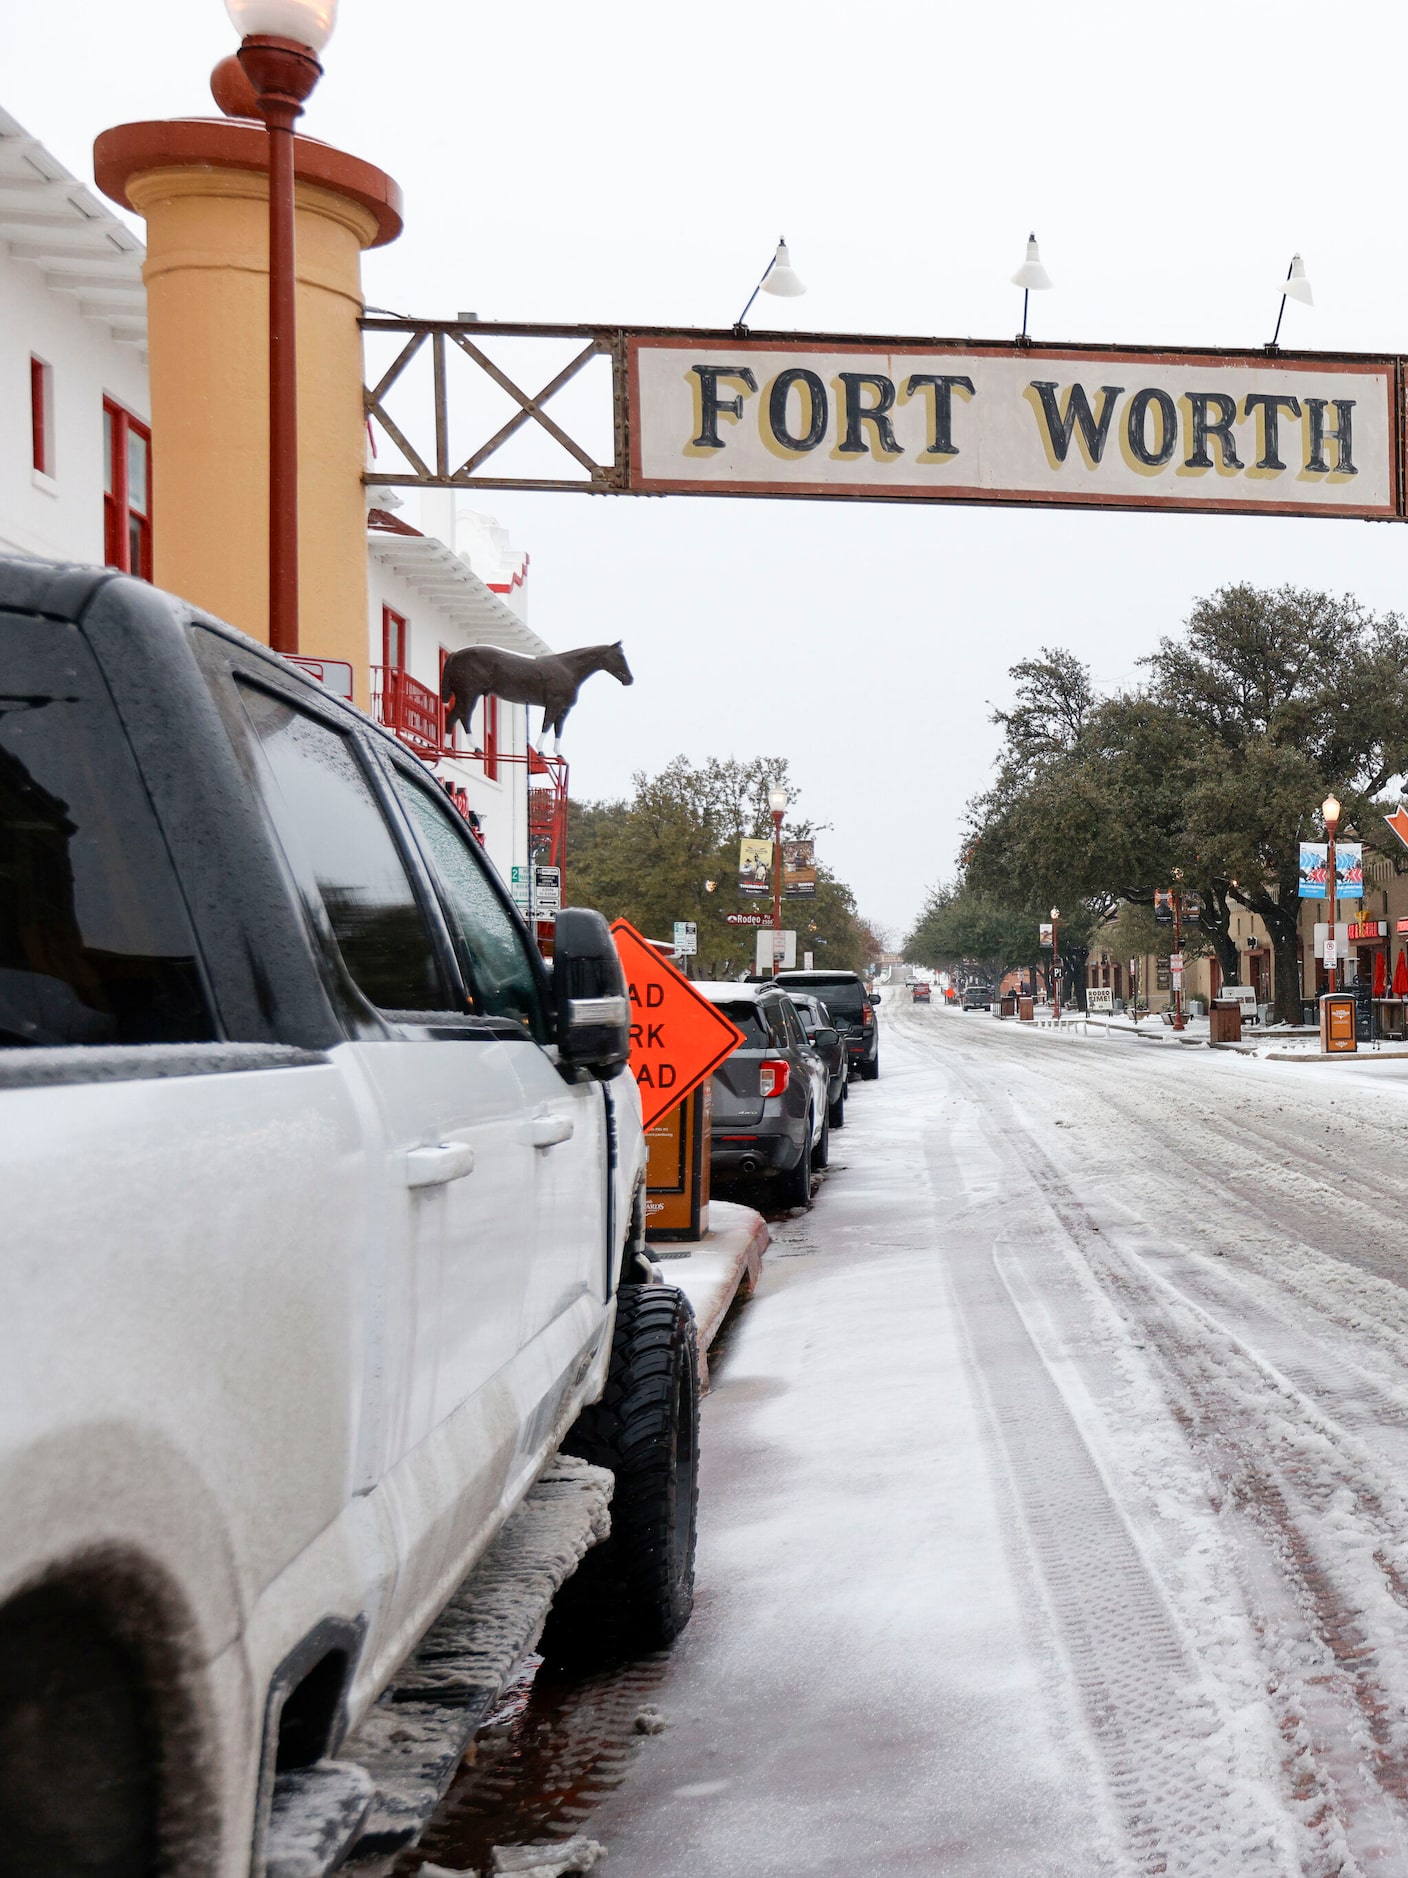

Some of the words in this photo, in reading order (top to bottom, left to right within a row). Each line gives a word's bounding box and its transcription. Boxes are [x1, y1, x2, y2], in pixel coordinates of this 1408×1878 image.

[686, 364, 976, 461] FORT
[1025, 380, 1360, 481] WORTH
[737, 914, 761, 923] Rodeo
[628, 983, 665, 1008] AD
[628, 1024, 665, 1048] RK
